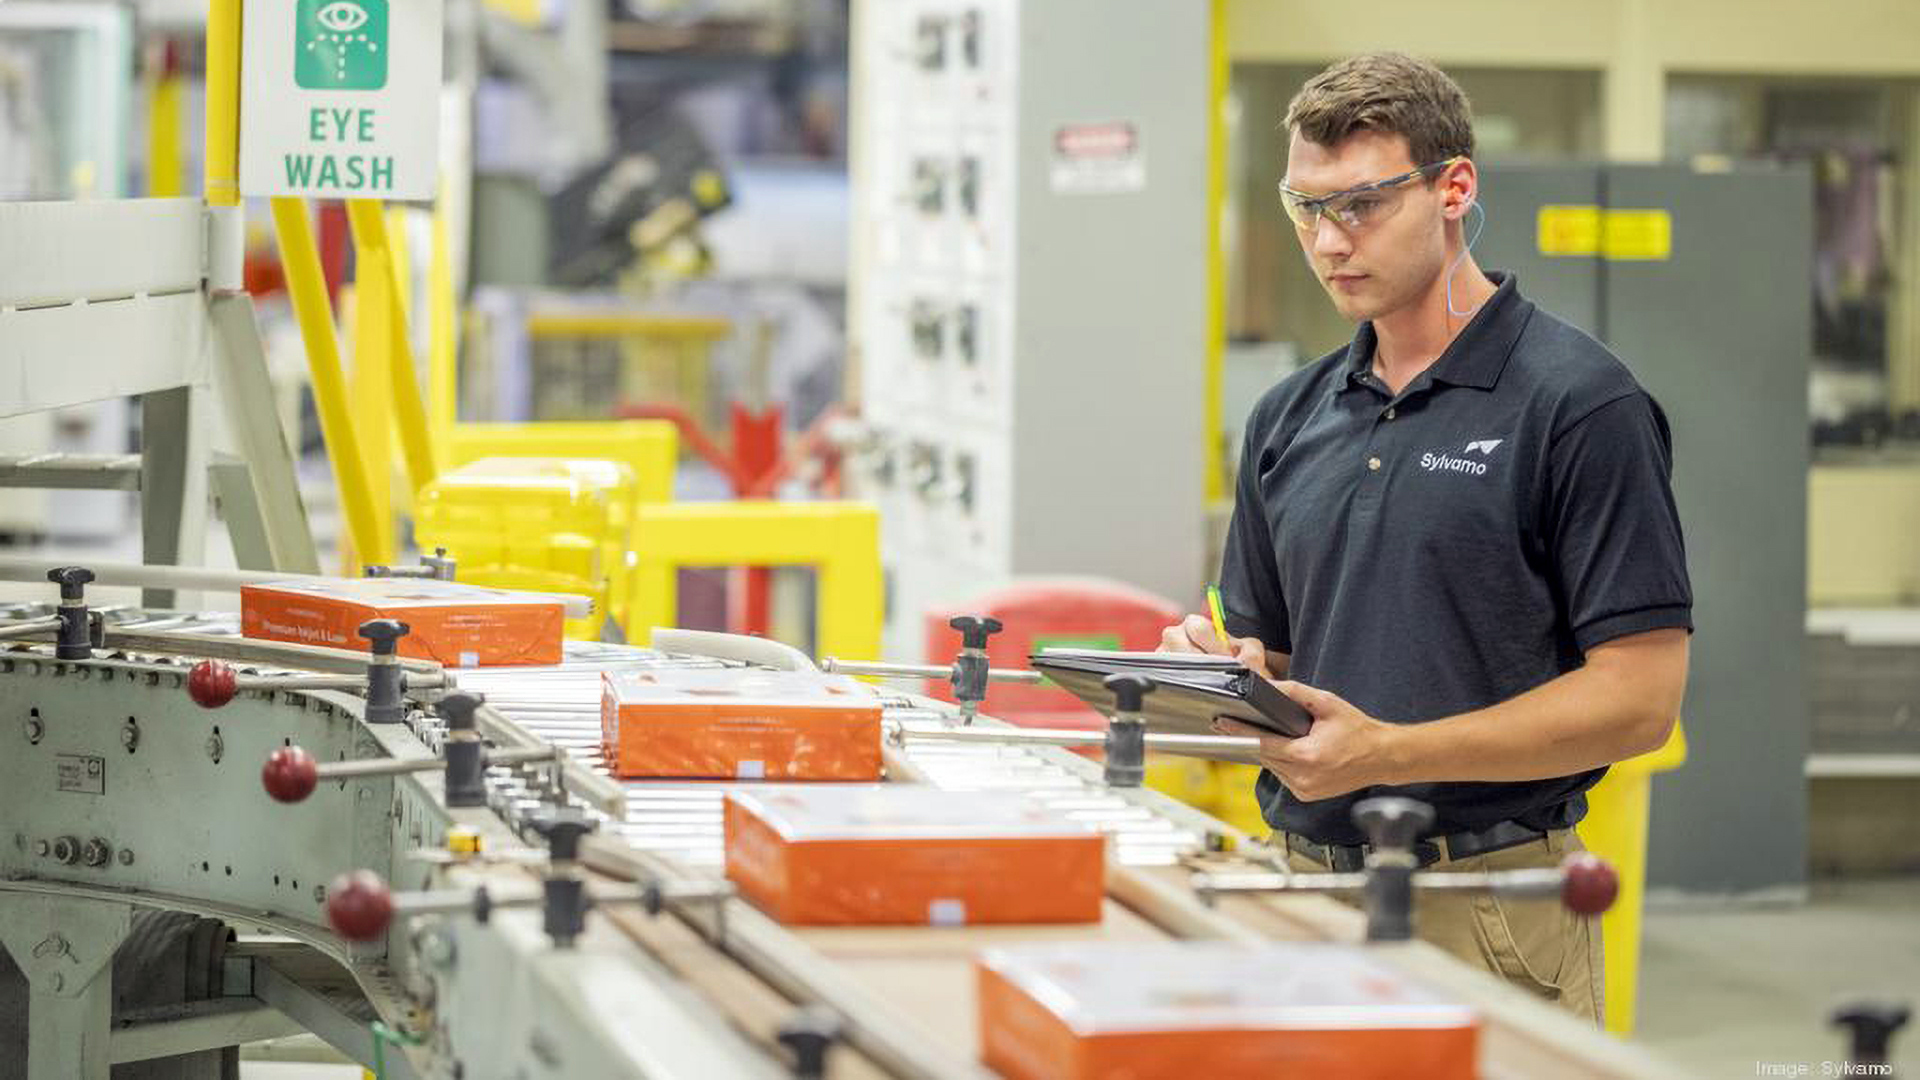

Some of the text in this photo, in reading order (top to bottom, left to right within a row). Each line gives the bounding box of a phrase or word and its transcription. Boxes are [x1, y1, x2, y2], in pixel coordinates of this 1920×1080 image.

[309, 108, 375, 142] EYE
[284, 154, 394, 190] WASH
[1420, 453, 1487, 475] Sylvamo
